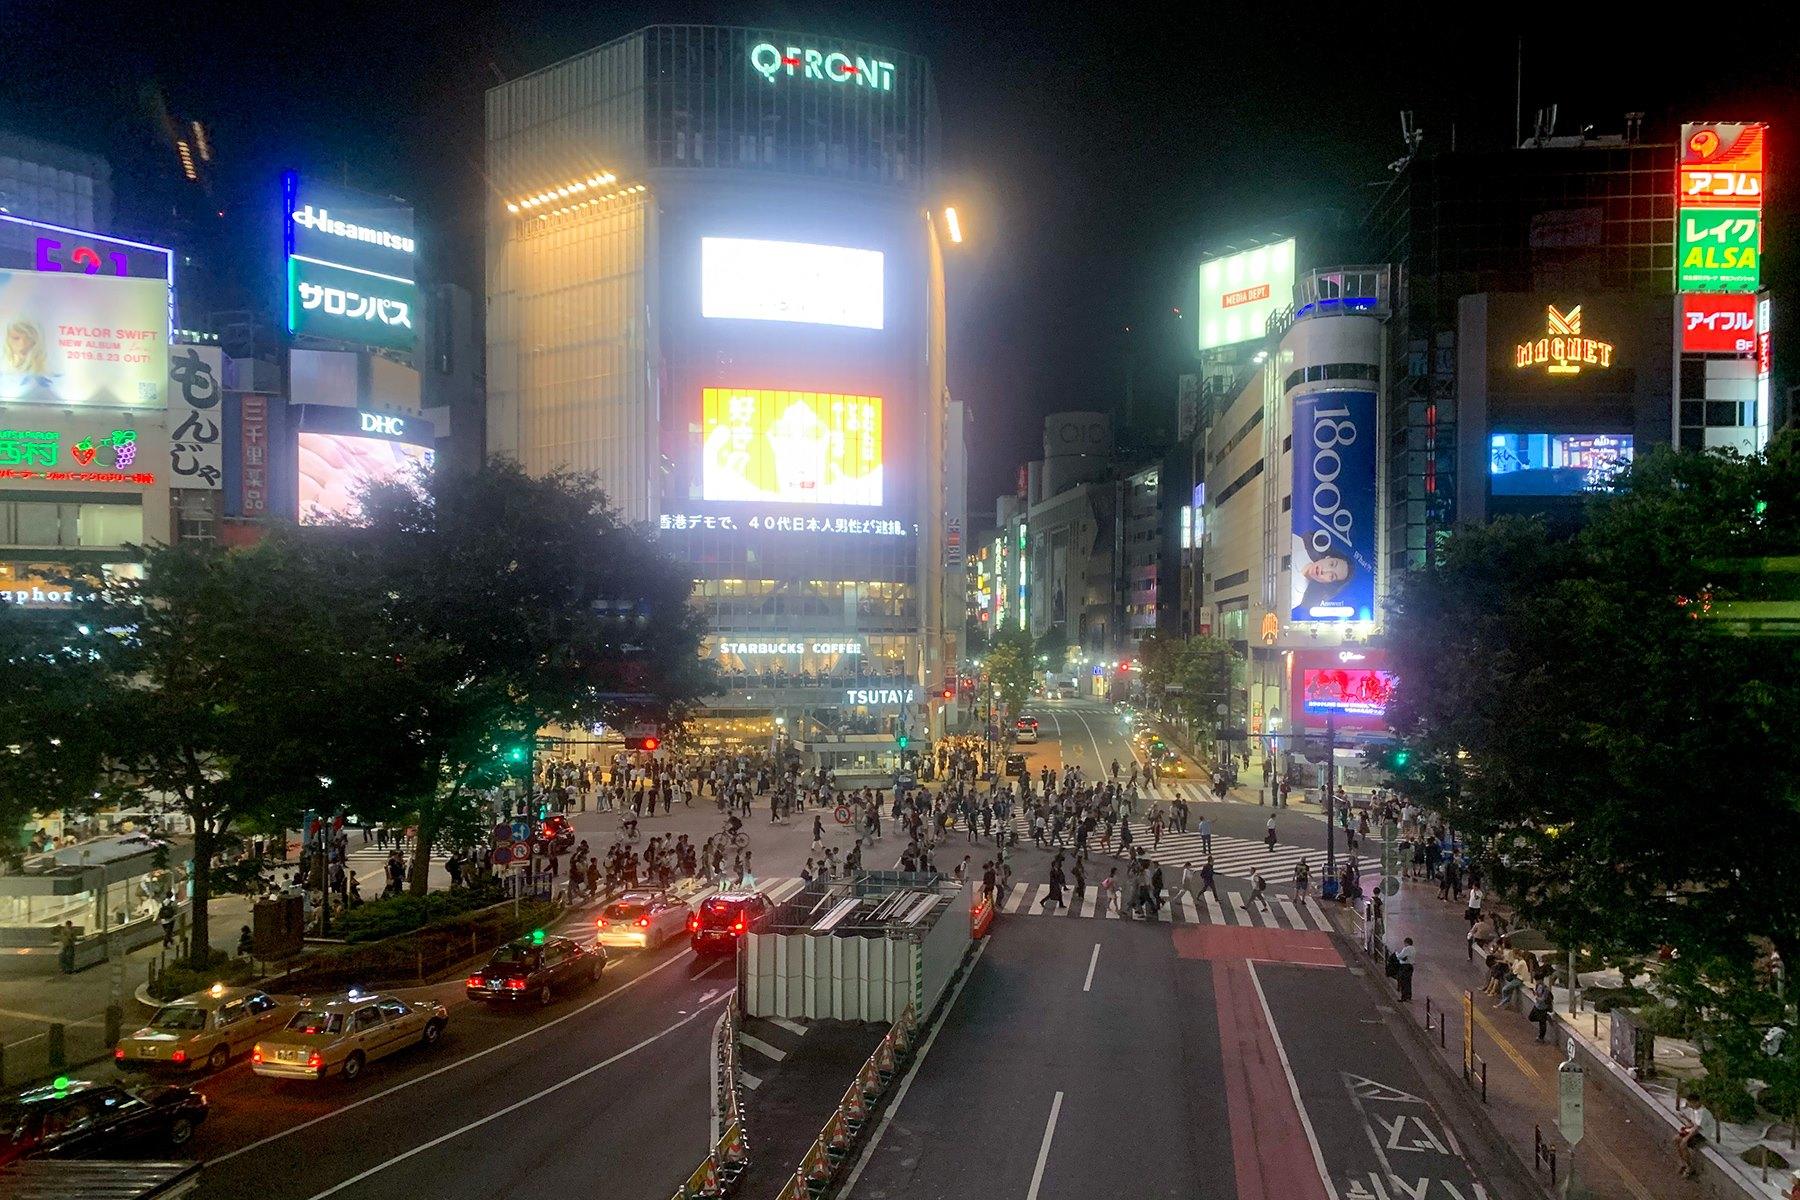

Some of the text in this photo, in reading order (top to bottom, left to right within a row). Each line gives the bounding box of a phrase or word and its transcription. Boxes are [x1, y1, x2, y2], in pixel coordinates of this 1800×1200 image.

[751, 43, 895, 90] QFRONT
[1688, 172, 1759, 196] アコム
[291, 205, 416, 253] Hisamitsu
[1686, 218, 1757, 243] レイク
[1683, 246, 1757, 269] ALSA
[298, 281, 412, 330] サロンパス
[1226, 292, 1249, 306] MEDIA
[59, 325, 158, 341] TAYLOR SWIFT
[1686, 312, 1754, 330] アイフル
[59, 339, 82, 348] NEW
[86, 340, 121, 350] ALBUM
[1517, 337, 1613, 368] MAGNET
[1735, 339, 1754, 351] 8F
[171, 348, 221, 486] もんじゃ
[361, 412, 404, 436] DHC
[1313, 402, 1357, 553] 1800%
[720, 642, 861, 654] STARBUCKS COFFEE
[847, 689, 914, 704] TSUTAYA
